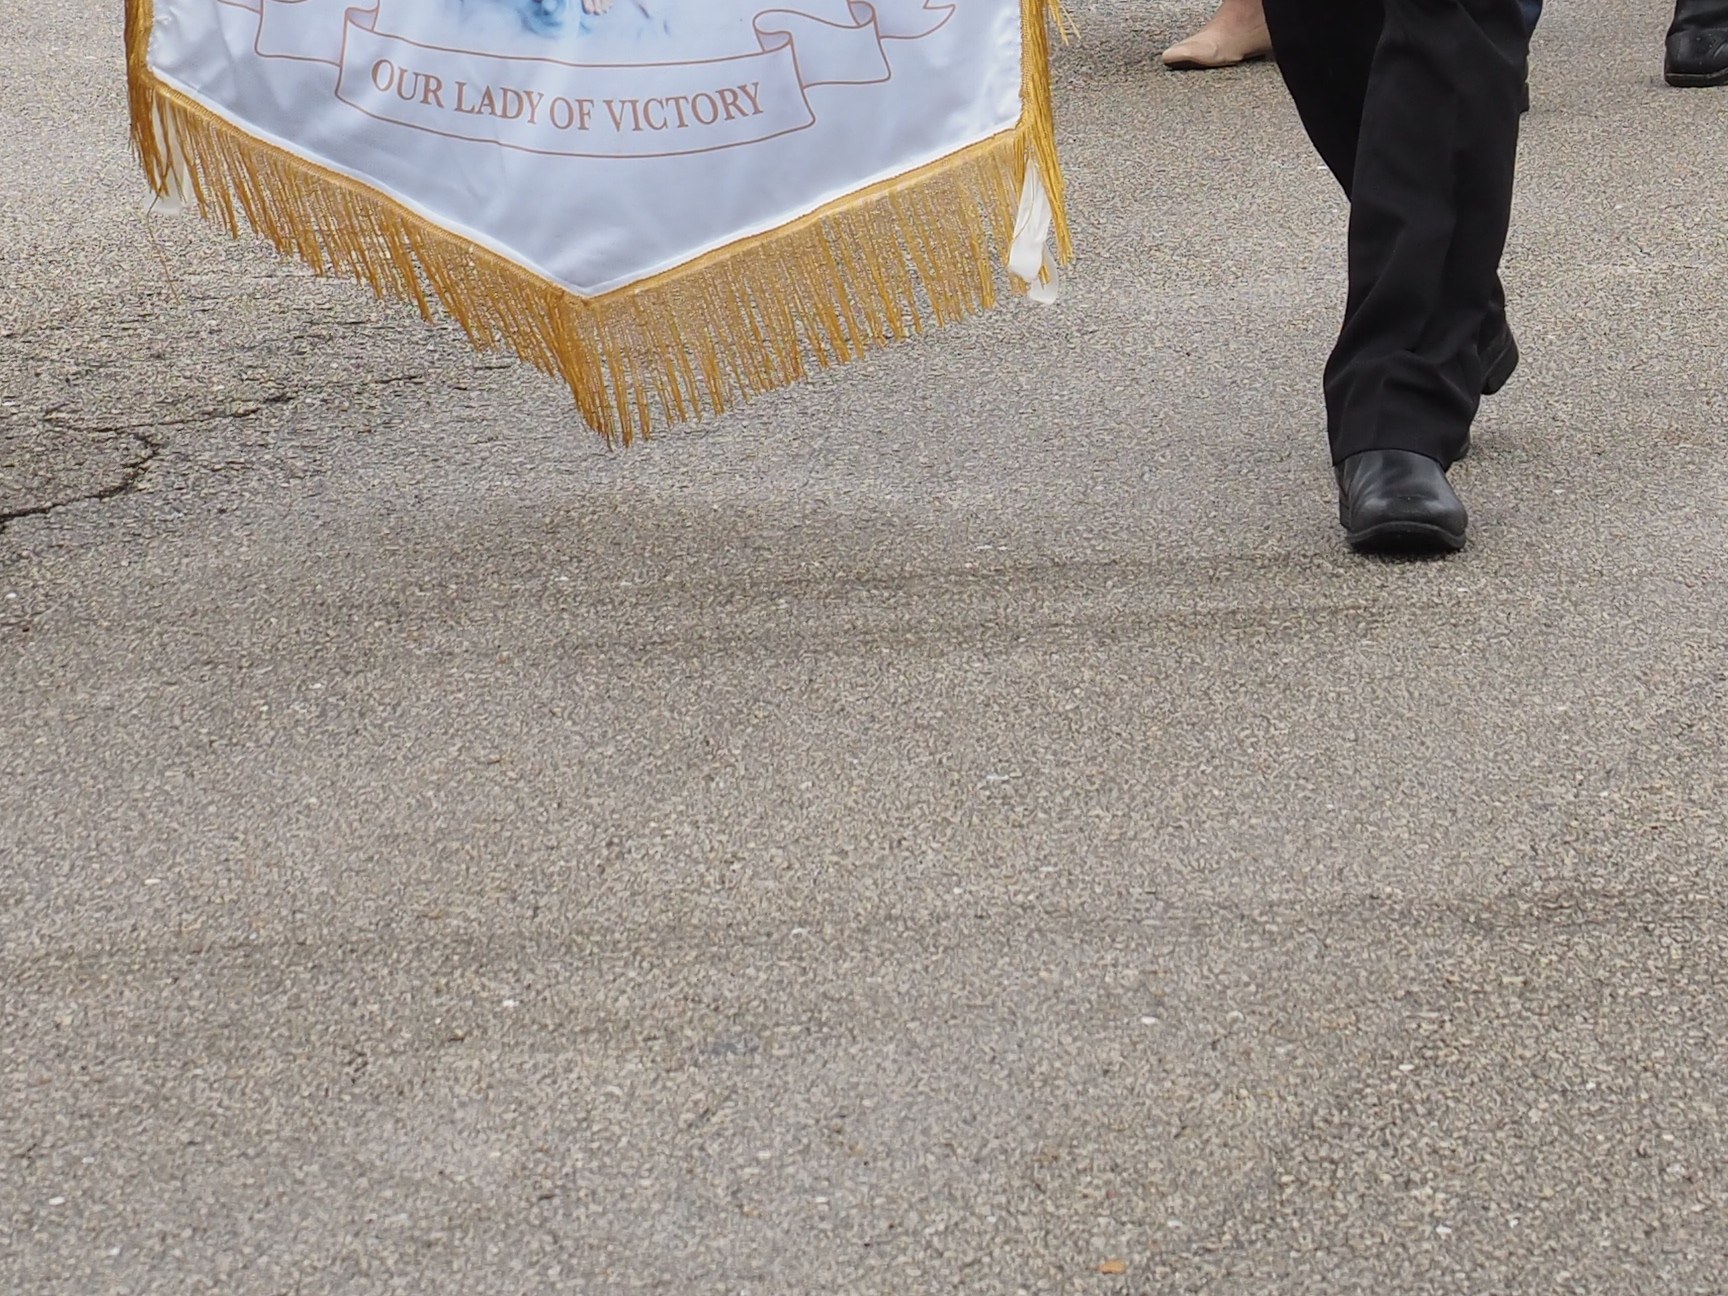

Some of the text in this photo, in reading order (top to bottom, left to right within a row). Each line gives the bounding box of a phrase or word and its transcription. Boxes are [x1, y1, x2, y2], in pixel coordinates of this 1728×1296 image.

[371, 59, 765, 132] OUR LADY OF VICTORY
